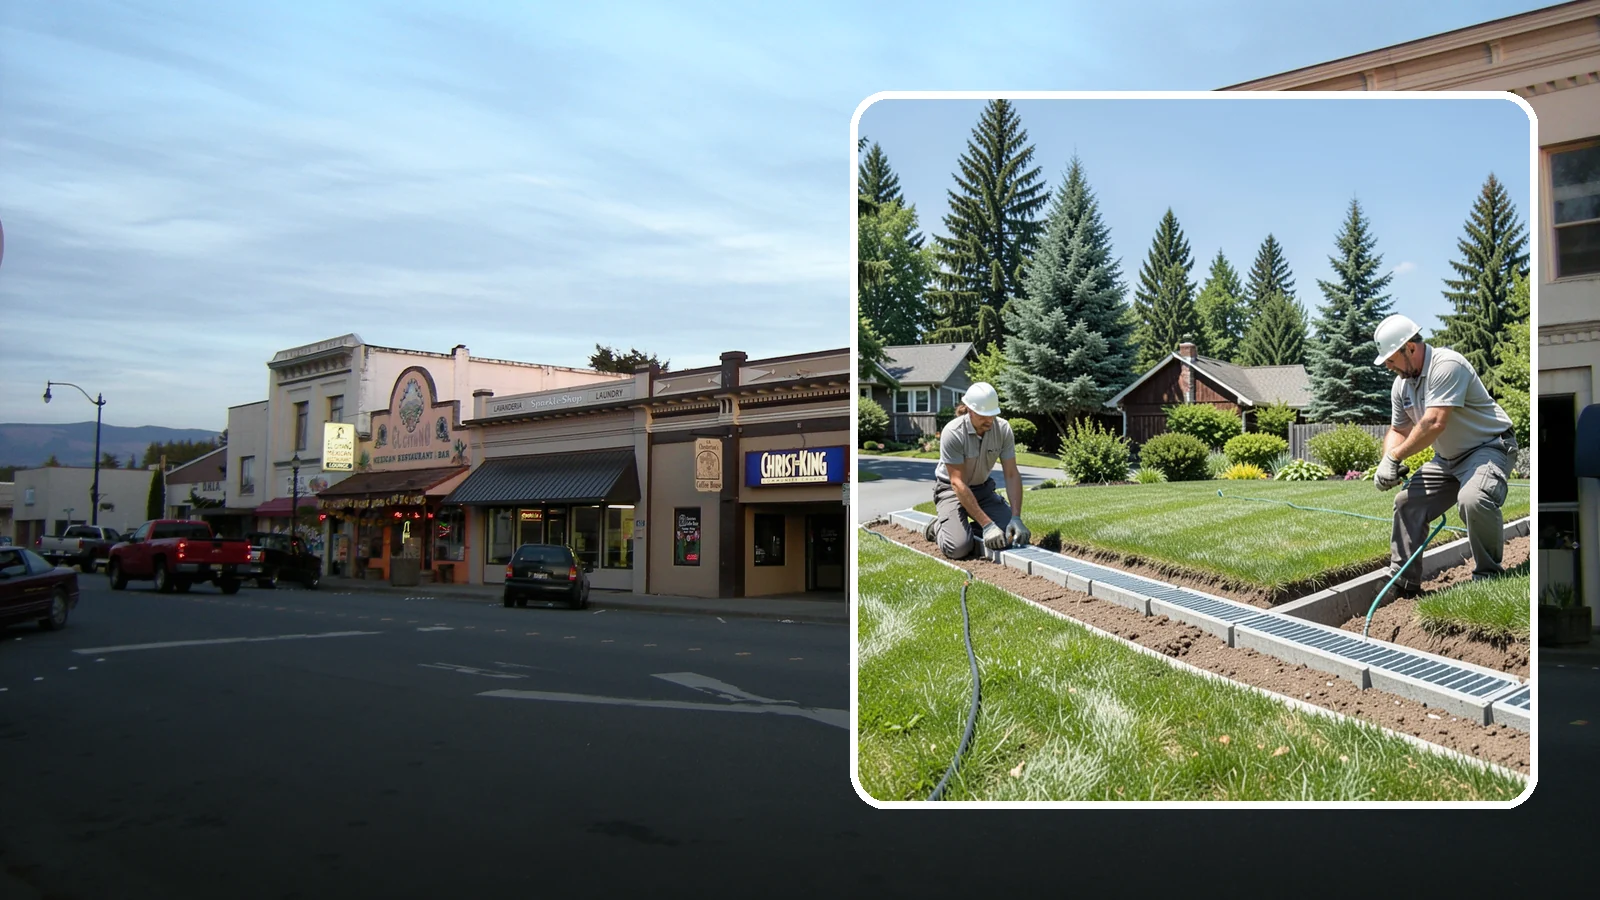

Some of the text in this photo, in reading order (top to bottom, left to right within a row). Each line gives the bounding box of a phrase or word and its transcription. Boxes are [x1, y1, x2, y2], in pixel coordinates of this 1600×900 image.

[561, 394, 582, 404] Shop
[595, 389, 623, 400] LAUNDRY
[493, 402, 522, 412] LAVANDERIA
[373, 450, 450, 464] MEXICAN RESTAURANT BAR
[760, 449, 827, 478] CHRIST KING
[696, 481, 709, 489] Coffee
